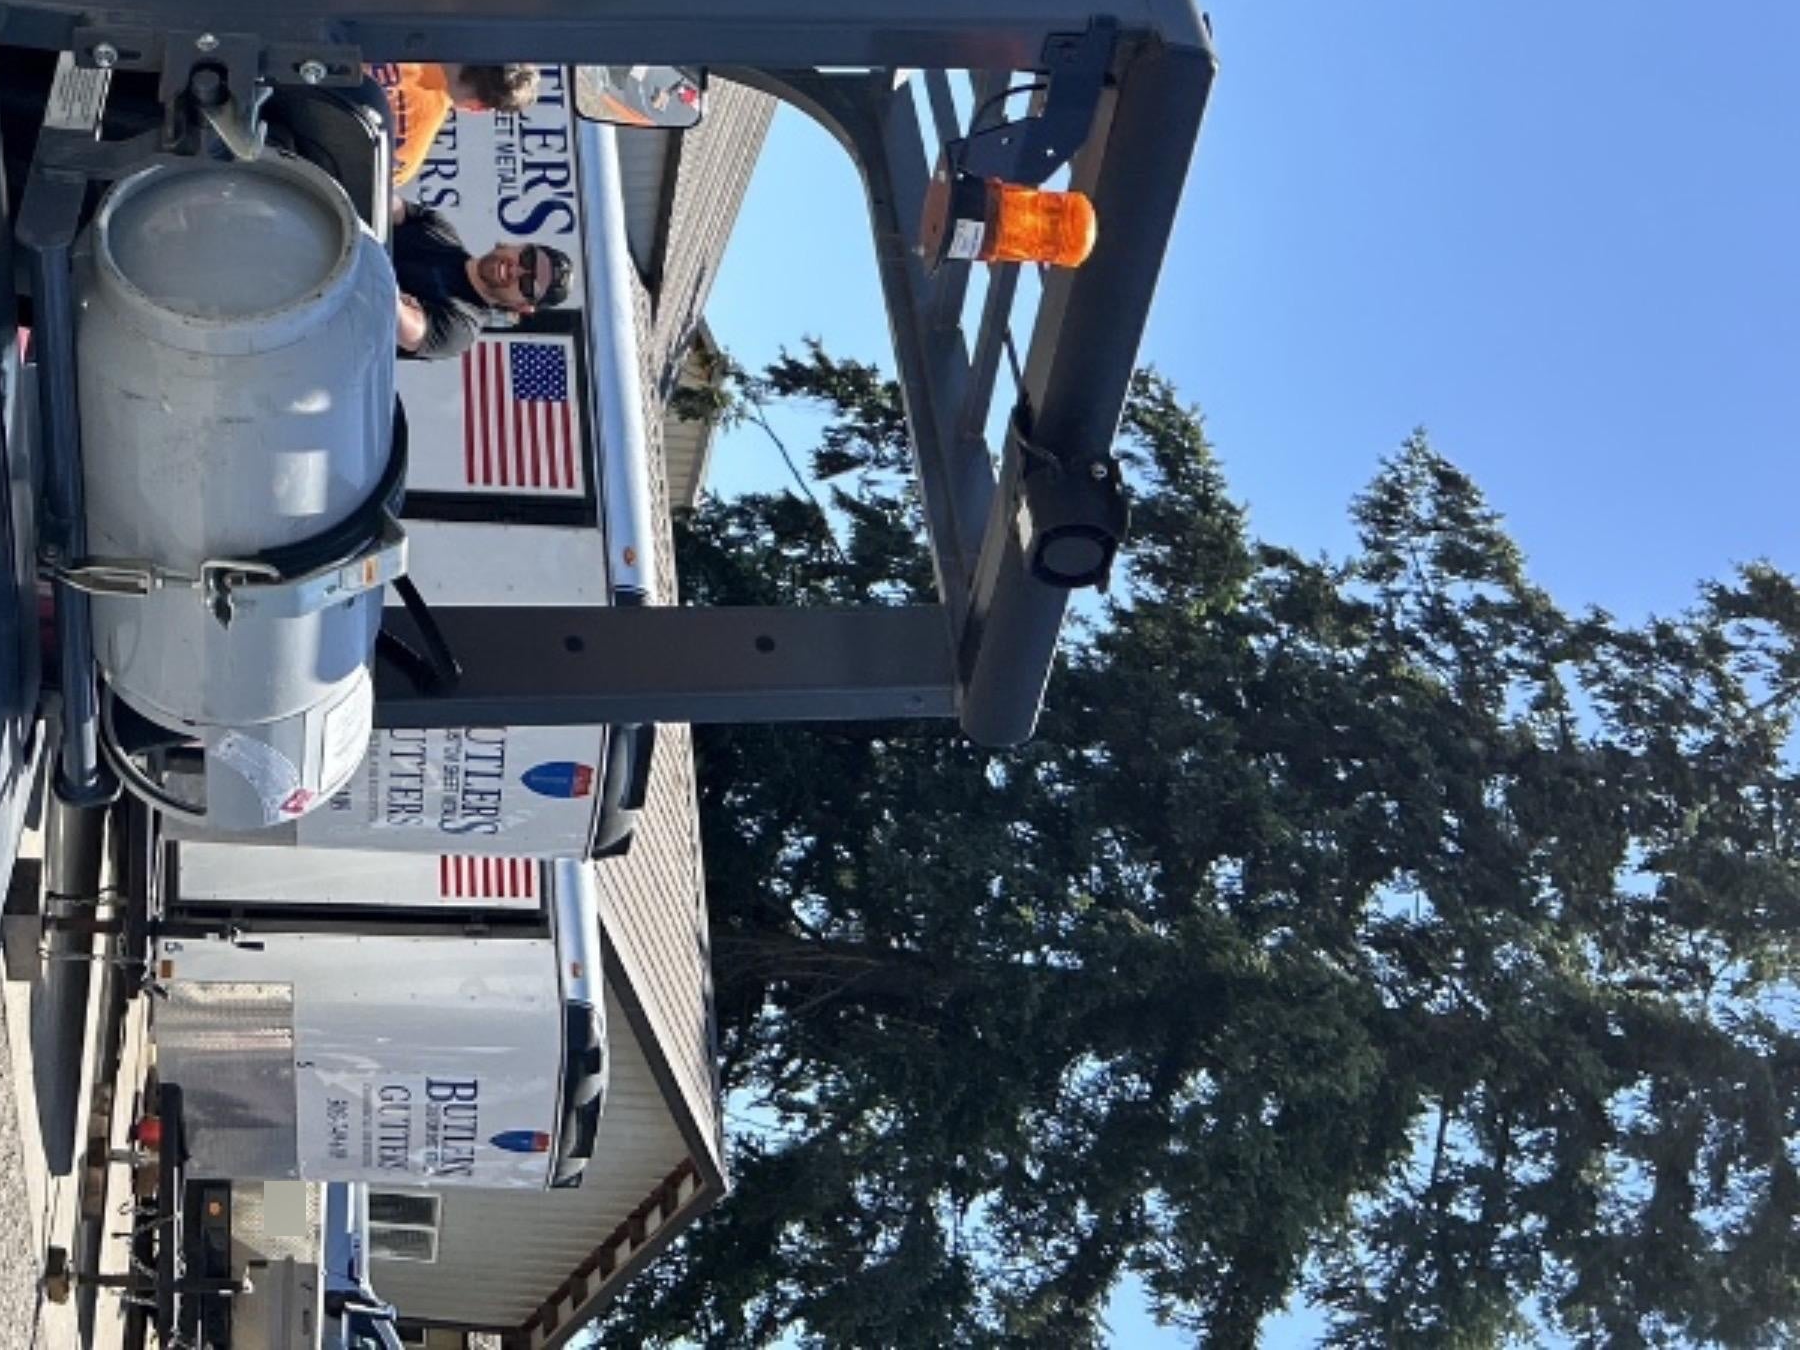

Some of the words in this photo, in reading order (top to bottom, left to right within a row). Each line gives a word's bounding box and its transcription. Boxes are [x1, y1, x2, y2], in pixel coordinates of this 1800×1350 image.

[494, 143, 518, 196] METAL
[497, 66, 576, 236] TLER'S
[387, 728, 427, 826] UTTERS
[438, 727, 506, 837] UTLER'S
